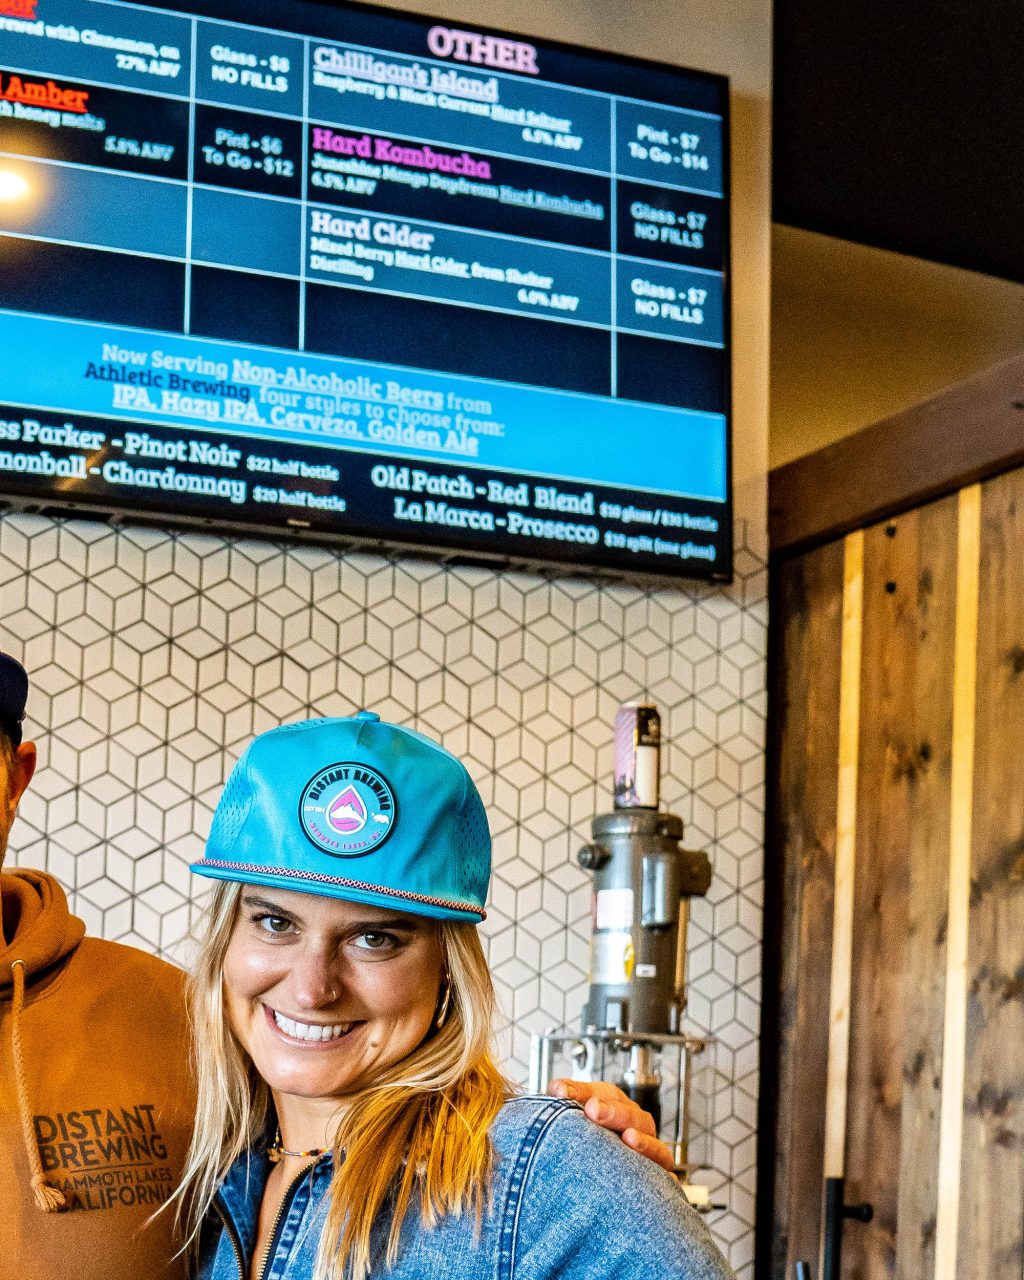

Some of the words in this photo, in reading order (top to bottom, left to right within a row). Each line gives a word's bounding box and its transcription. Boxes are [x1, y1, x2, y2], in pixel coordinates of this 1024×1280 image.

[211, 45, 258, 67] Glass
[428, 25, 539, 75] OTHER
[6, 76, 89, 109] Amber
[212, 65, 238, 83] NO
[241, 70, 288, 93] FILLS
[314, 47, 429, 87] Chilligan's
[431, 68, 499, 103] Island
[215, 128, 250, 150] Pint
[261, 136, 282, 155] $6
[637, 124, 669, 145] Pint
[202, 146, 224, 165] To
[226, 150, 251, 170] Go
[265, 155, 294, 177] $12
[312, 128, 371, 158] Hard
[374, 139, 492, 179] Kombucha
[628, 142, 648, 160] To
[649, 146, 672, 165] Go
[311, 211, 370, 241] Hard
[373, 221, 434, 250] Cider
[630, 201, 676, 225] Glass
[634, 222, 659, 240] NO
[661, 226, 704, 249] FILLS
[631, 278, 676, 300] Glass
[635, 299, 660, 316] NO
[661, 303, 704, 324] FILLS
[102, 343, 148, 365] Now
[151, 351, 228, 381] Serving
[232, 359, 382, 399] Non-Alcoholic
[386, 381, 444, 411] Beers
[448, 392, 492, 415] from
[84, 363, 163, 389] Athletic
[259, 387, 301, 409] four
[305, 394, 361, 417] styles
[365, 402, 384, 419] to
[388, 406, 451, 429] choose
[455, 414, 506, 436] from:
[113, 384, 158, 409] IPA,
[161, 391, 219, 421] Hazy
[368, 420, 441, 449] Golden
[445, 431, 479, 456] Ale
[22, 420, 105, 450] Parker
[125, 433, 186, 460] Pinot
[190, 441, 241, 468] Noir
[103, 461, 246, 503] Chardonnay
[371, 466, 409, 492] Old
[412, 472, 475, 500] Patch
[487, 481, 529, 506] Red
[534, 487, 595, 516] Blend
[394, 498, 423, 521] La
[425, 501, 494, 531] Marca
[507, 512, 599, 545] Prosecco
[309, 769, 350, 800] DISTANT
[32, 1104, 156, 1144] DISTANT
[38, 1134, 168, 1172] BREWING
[137, 1168, 173, 1181] LAKES
